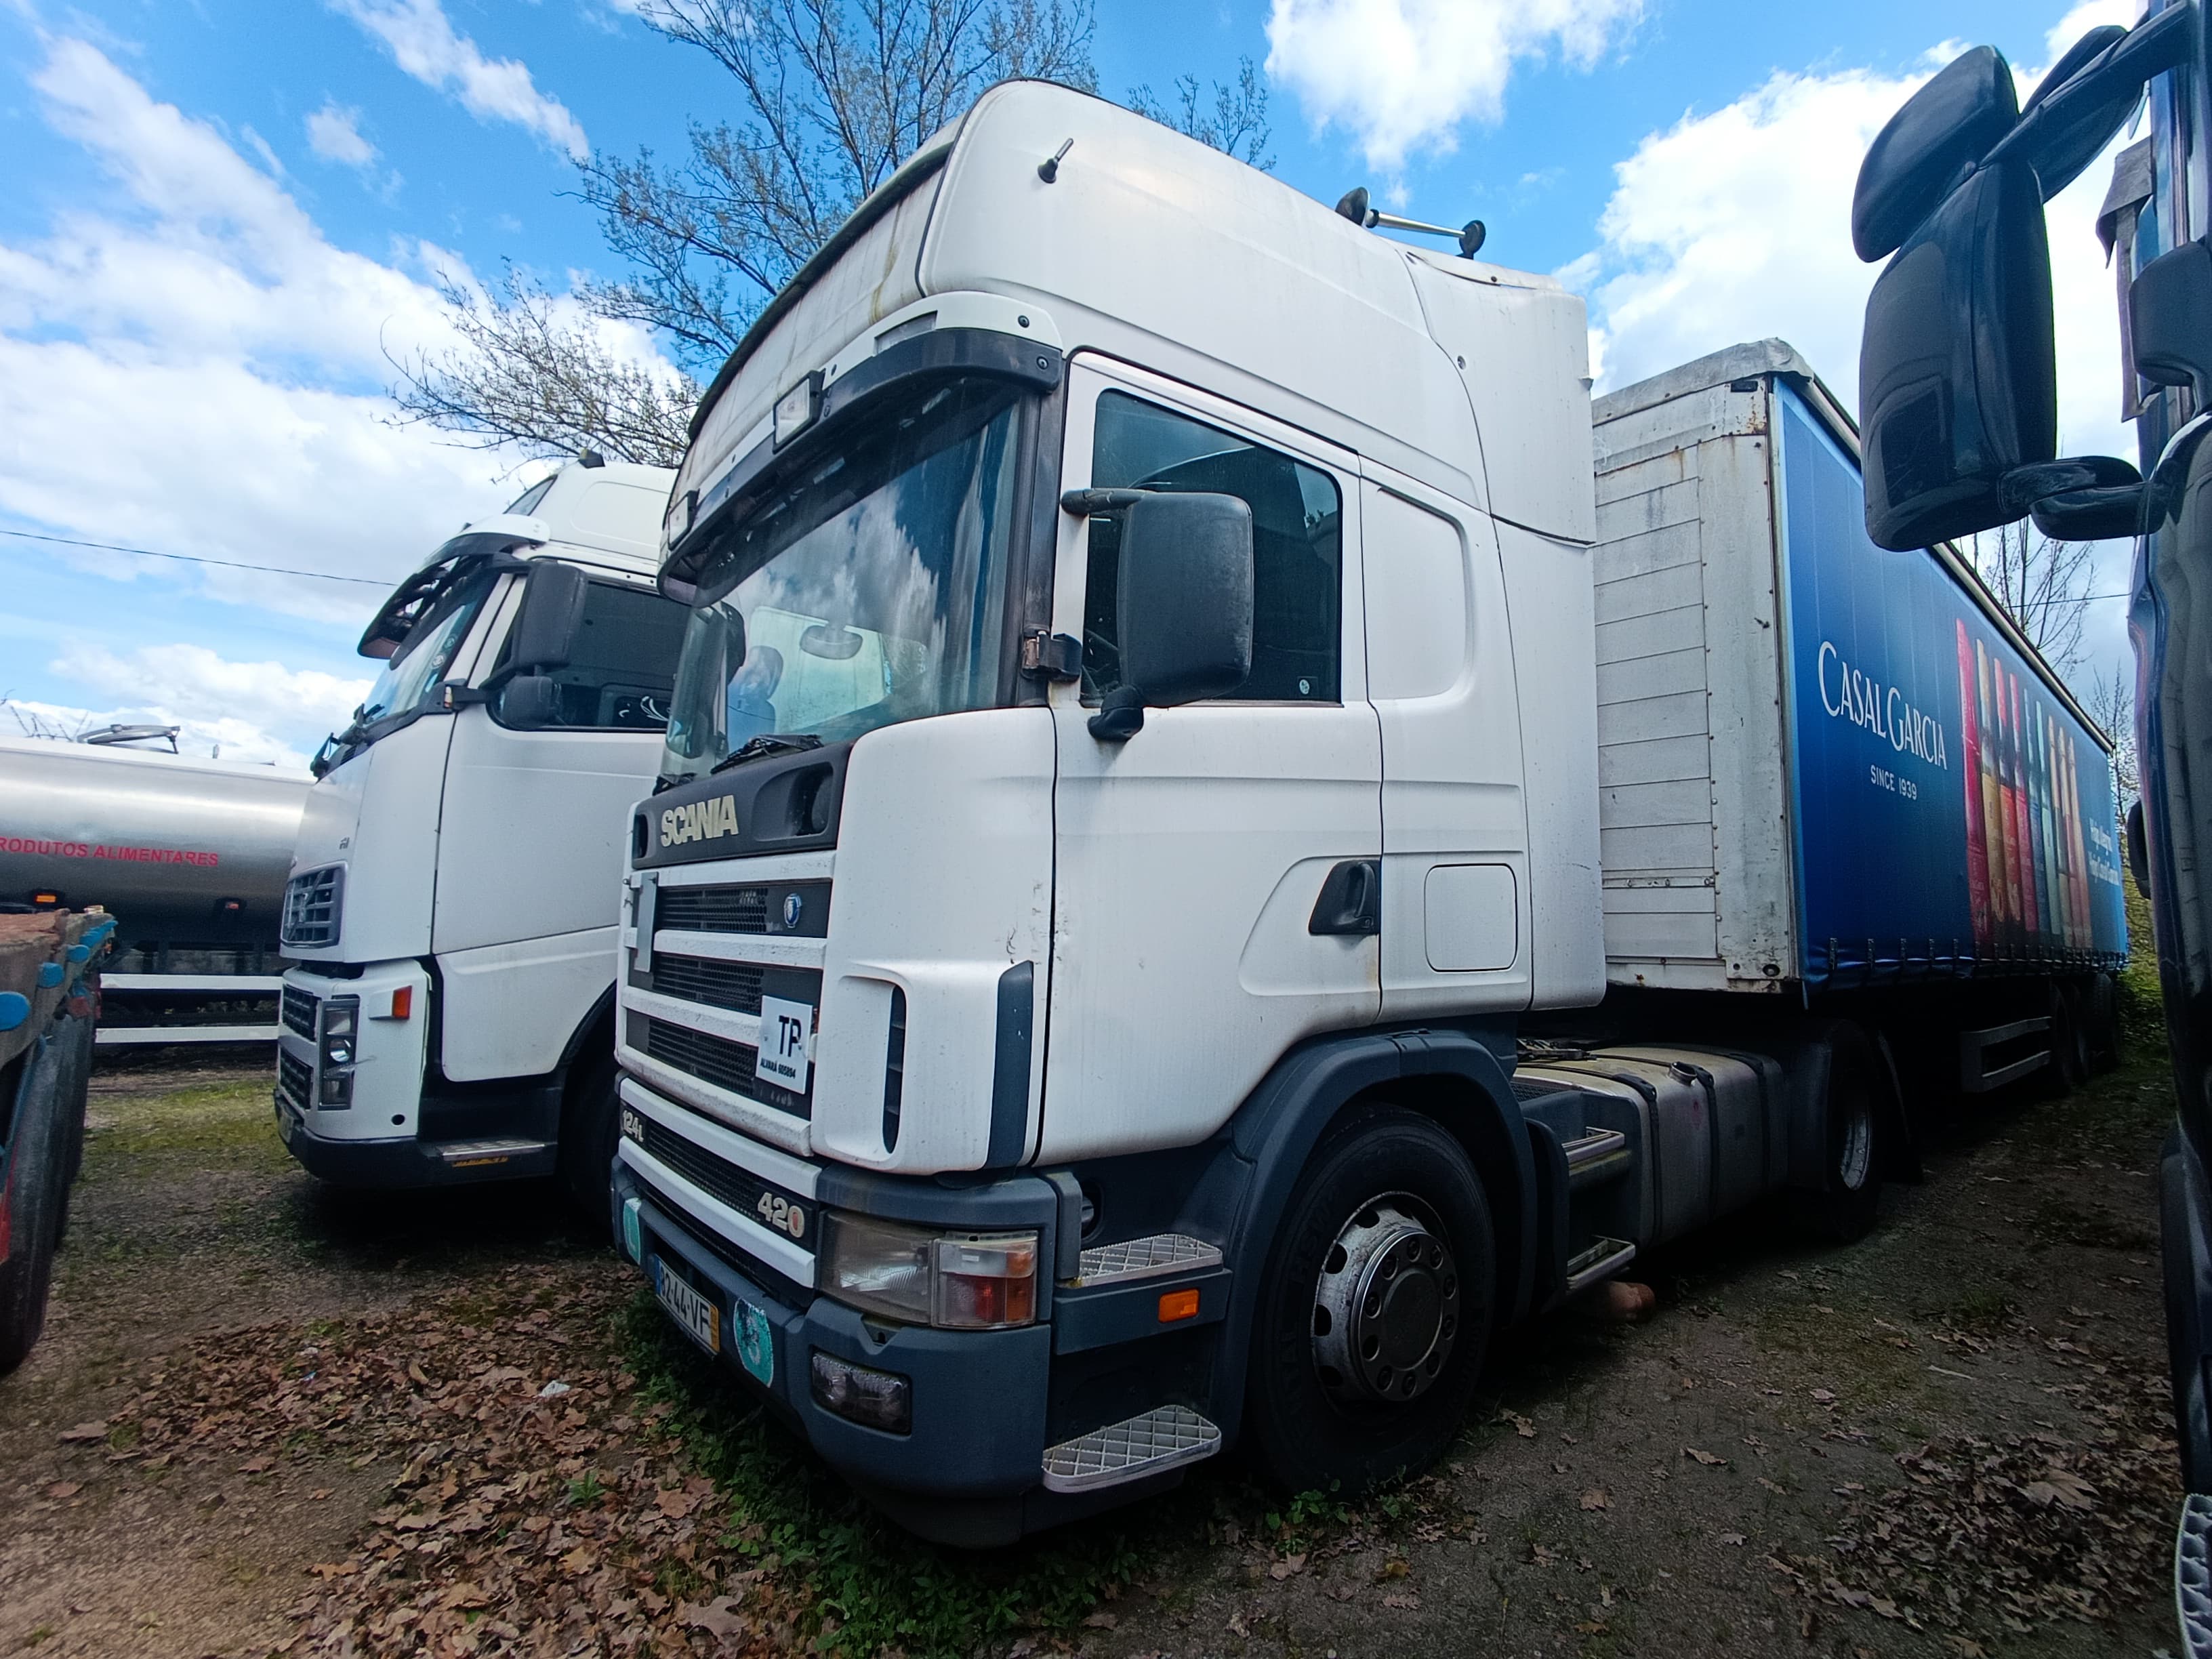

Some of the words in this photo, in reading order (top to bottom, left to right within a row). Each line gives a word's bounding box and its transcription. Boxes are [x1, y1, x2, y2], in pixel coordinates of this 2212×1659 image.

[1818, 640, 1886, 738] CASAL
[1887, 687, 1947, 771] GARCIA
[1870, 764, 1896, 792] SINCE
[1898, 777, 1918, 801] 1939
[660, 794, 739, 848] SCANIA
[93, 844, 219, 867] ALIMENTARES
[778, 1015, 802, 1058] TP
[757, 1191, 805, 1238] 420
